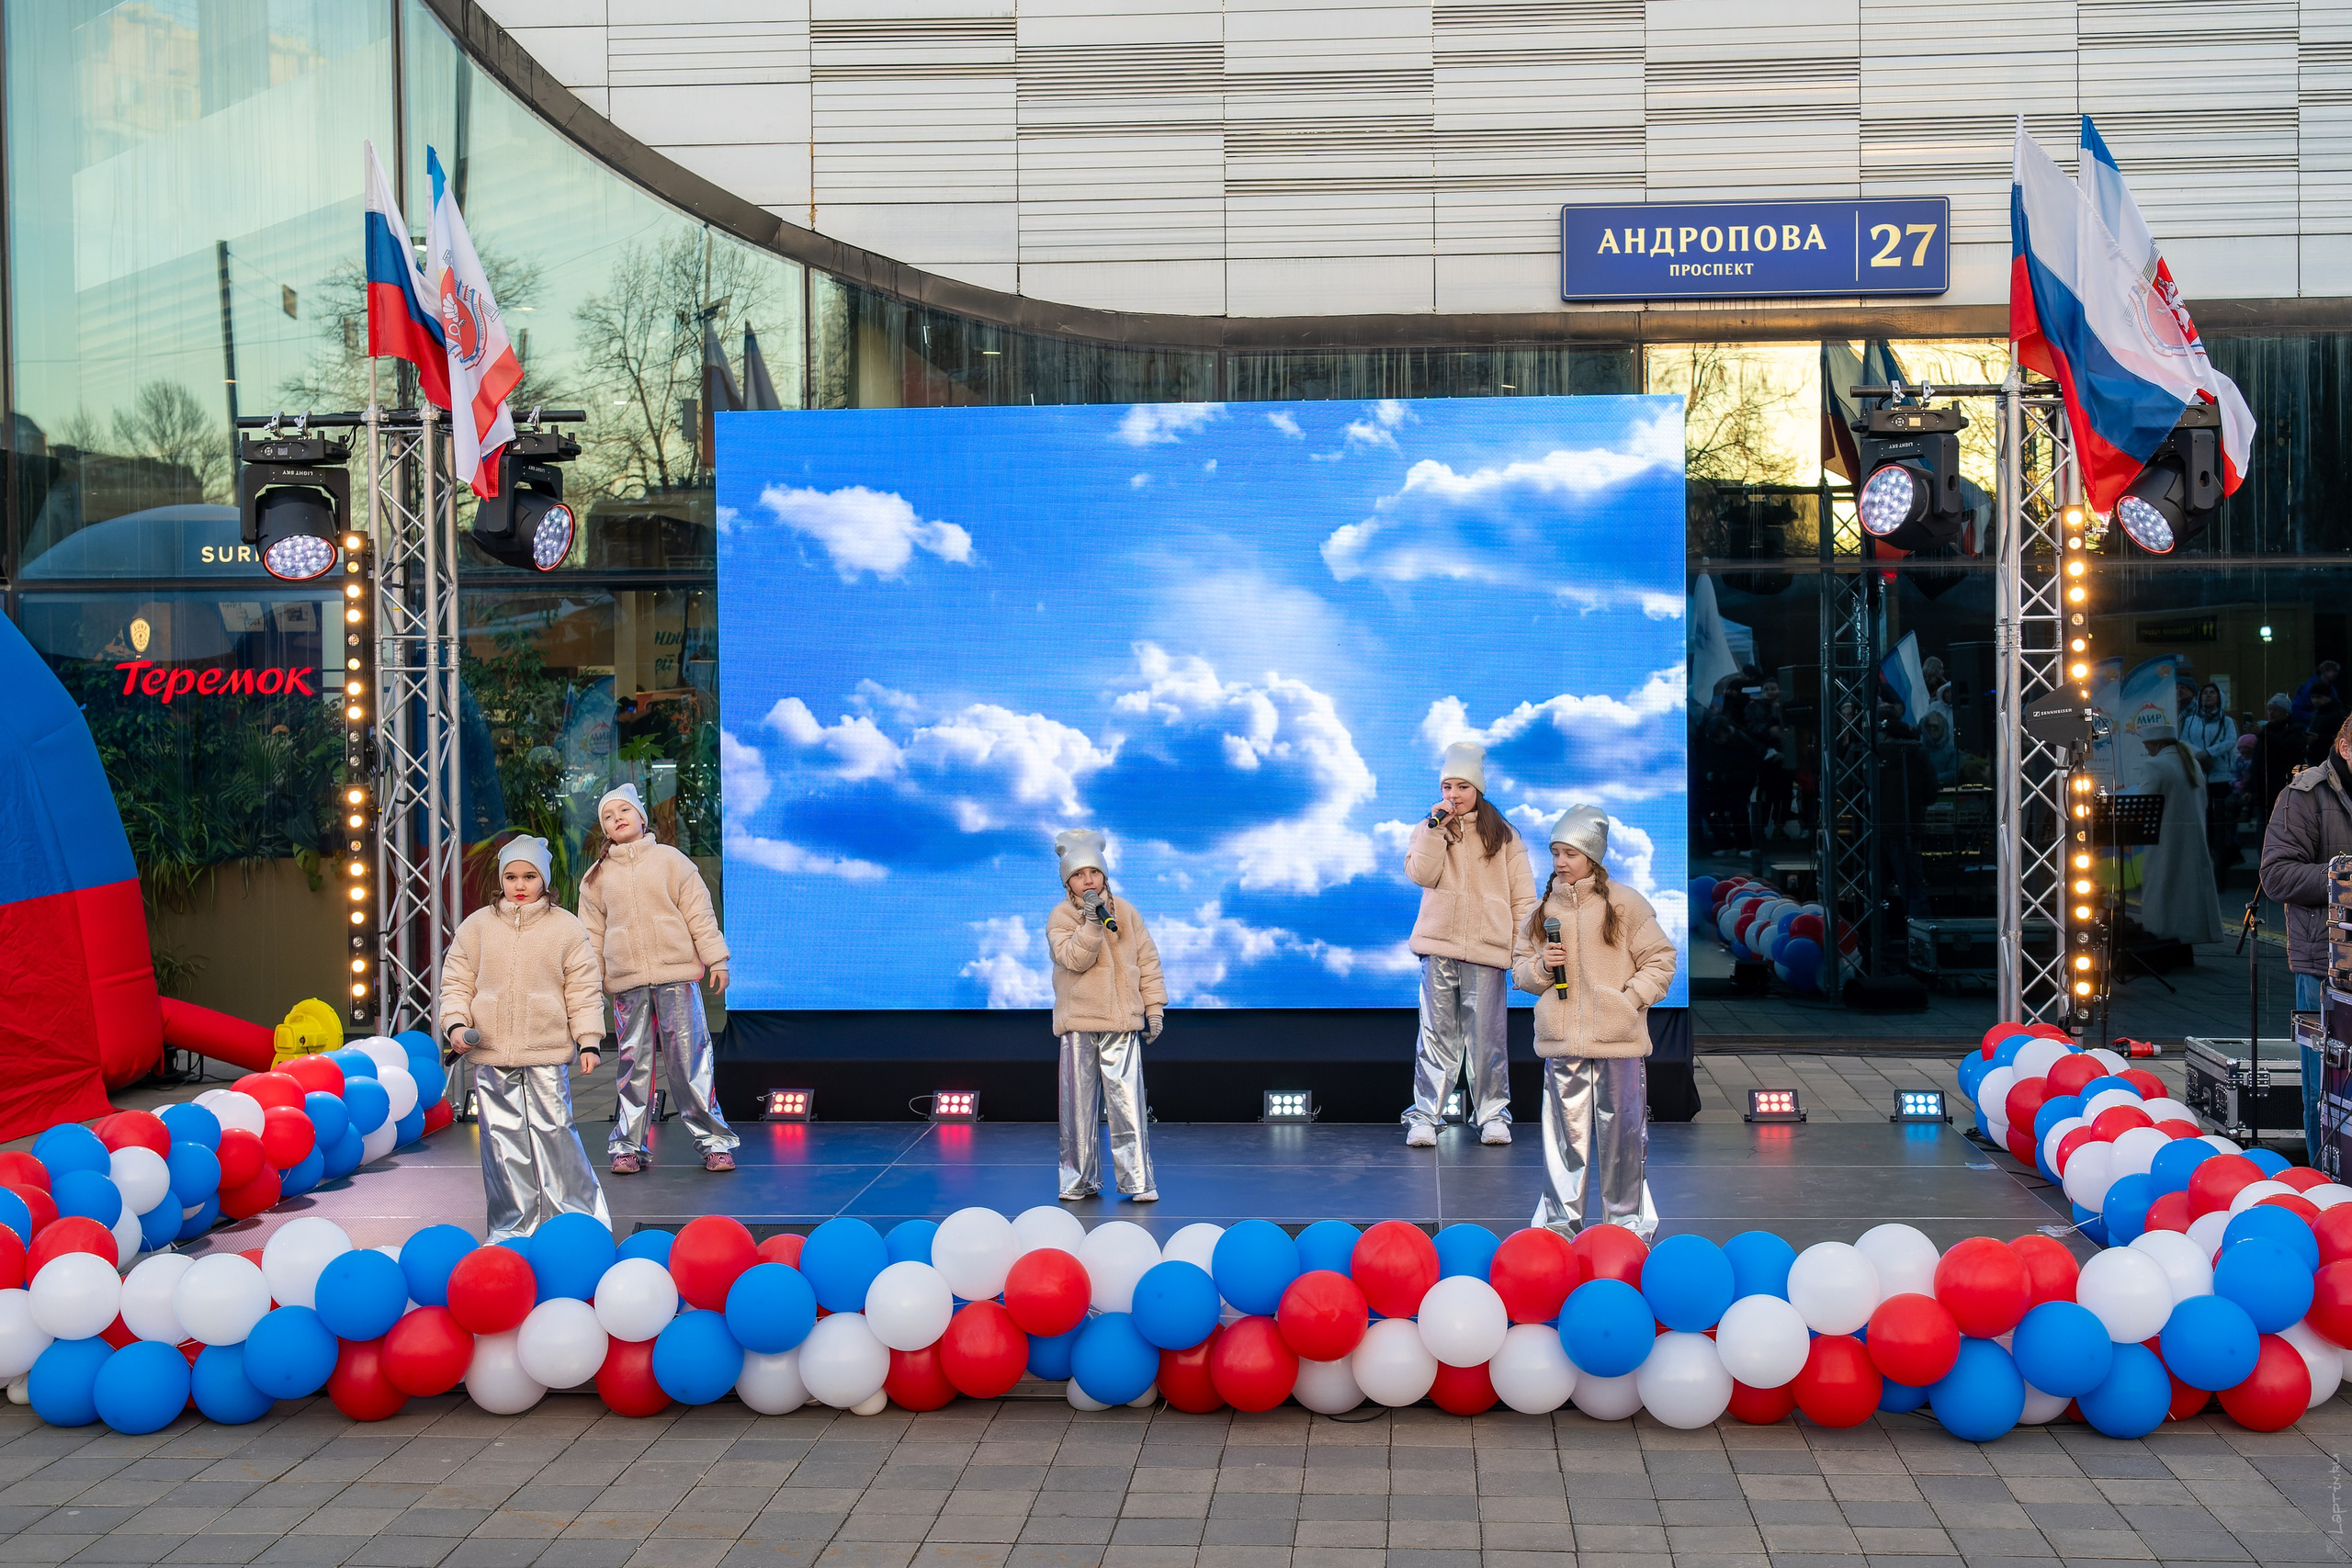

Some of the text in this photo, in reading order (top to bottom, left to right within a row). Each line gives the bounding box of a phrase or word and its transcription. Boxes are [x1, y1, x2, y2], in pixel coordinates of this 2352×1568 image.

[1597, 223, 1827, 258] АНДРОПОВА
[1869, 223, 1939, 267] 27
[1669, 262, 1754, 276] ПРОСПЕКТ
[114, 660, 313, 705] Теремок
[2136, 714, 2162, 725] МИР
